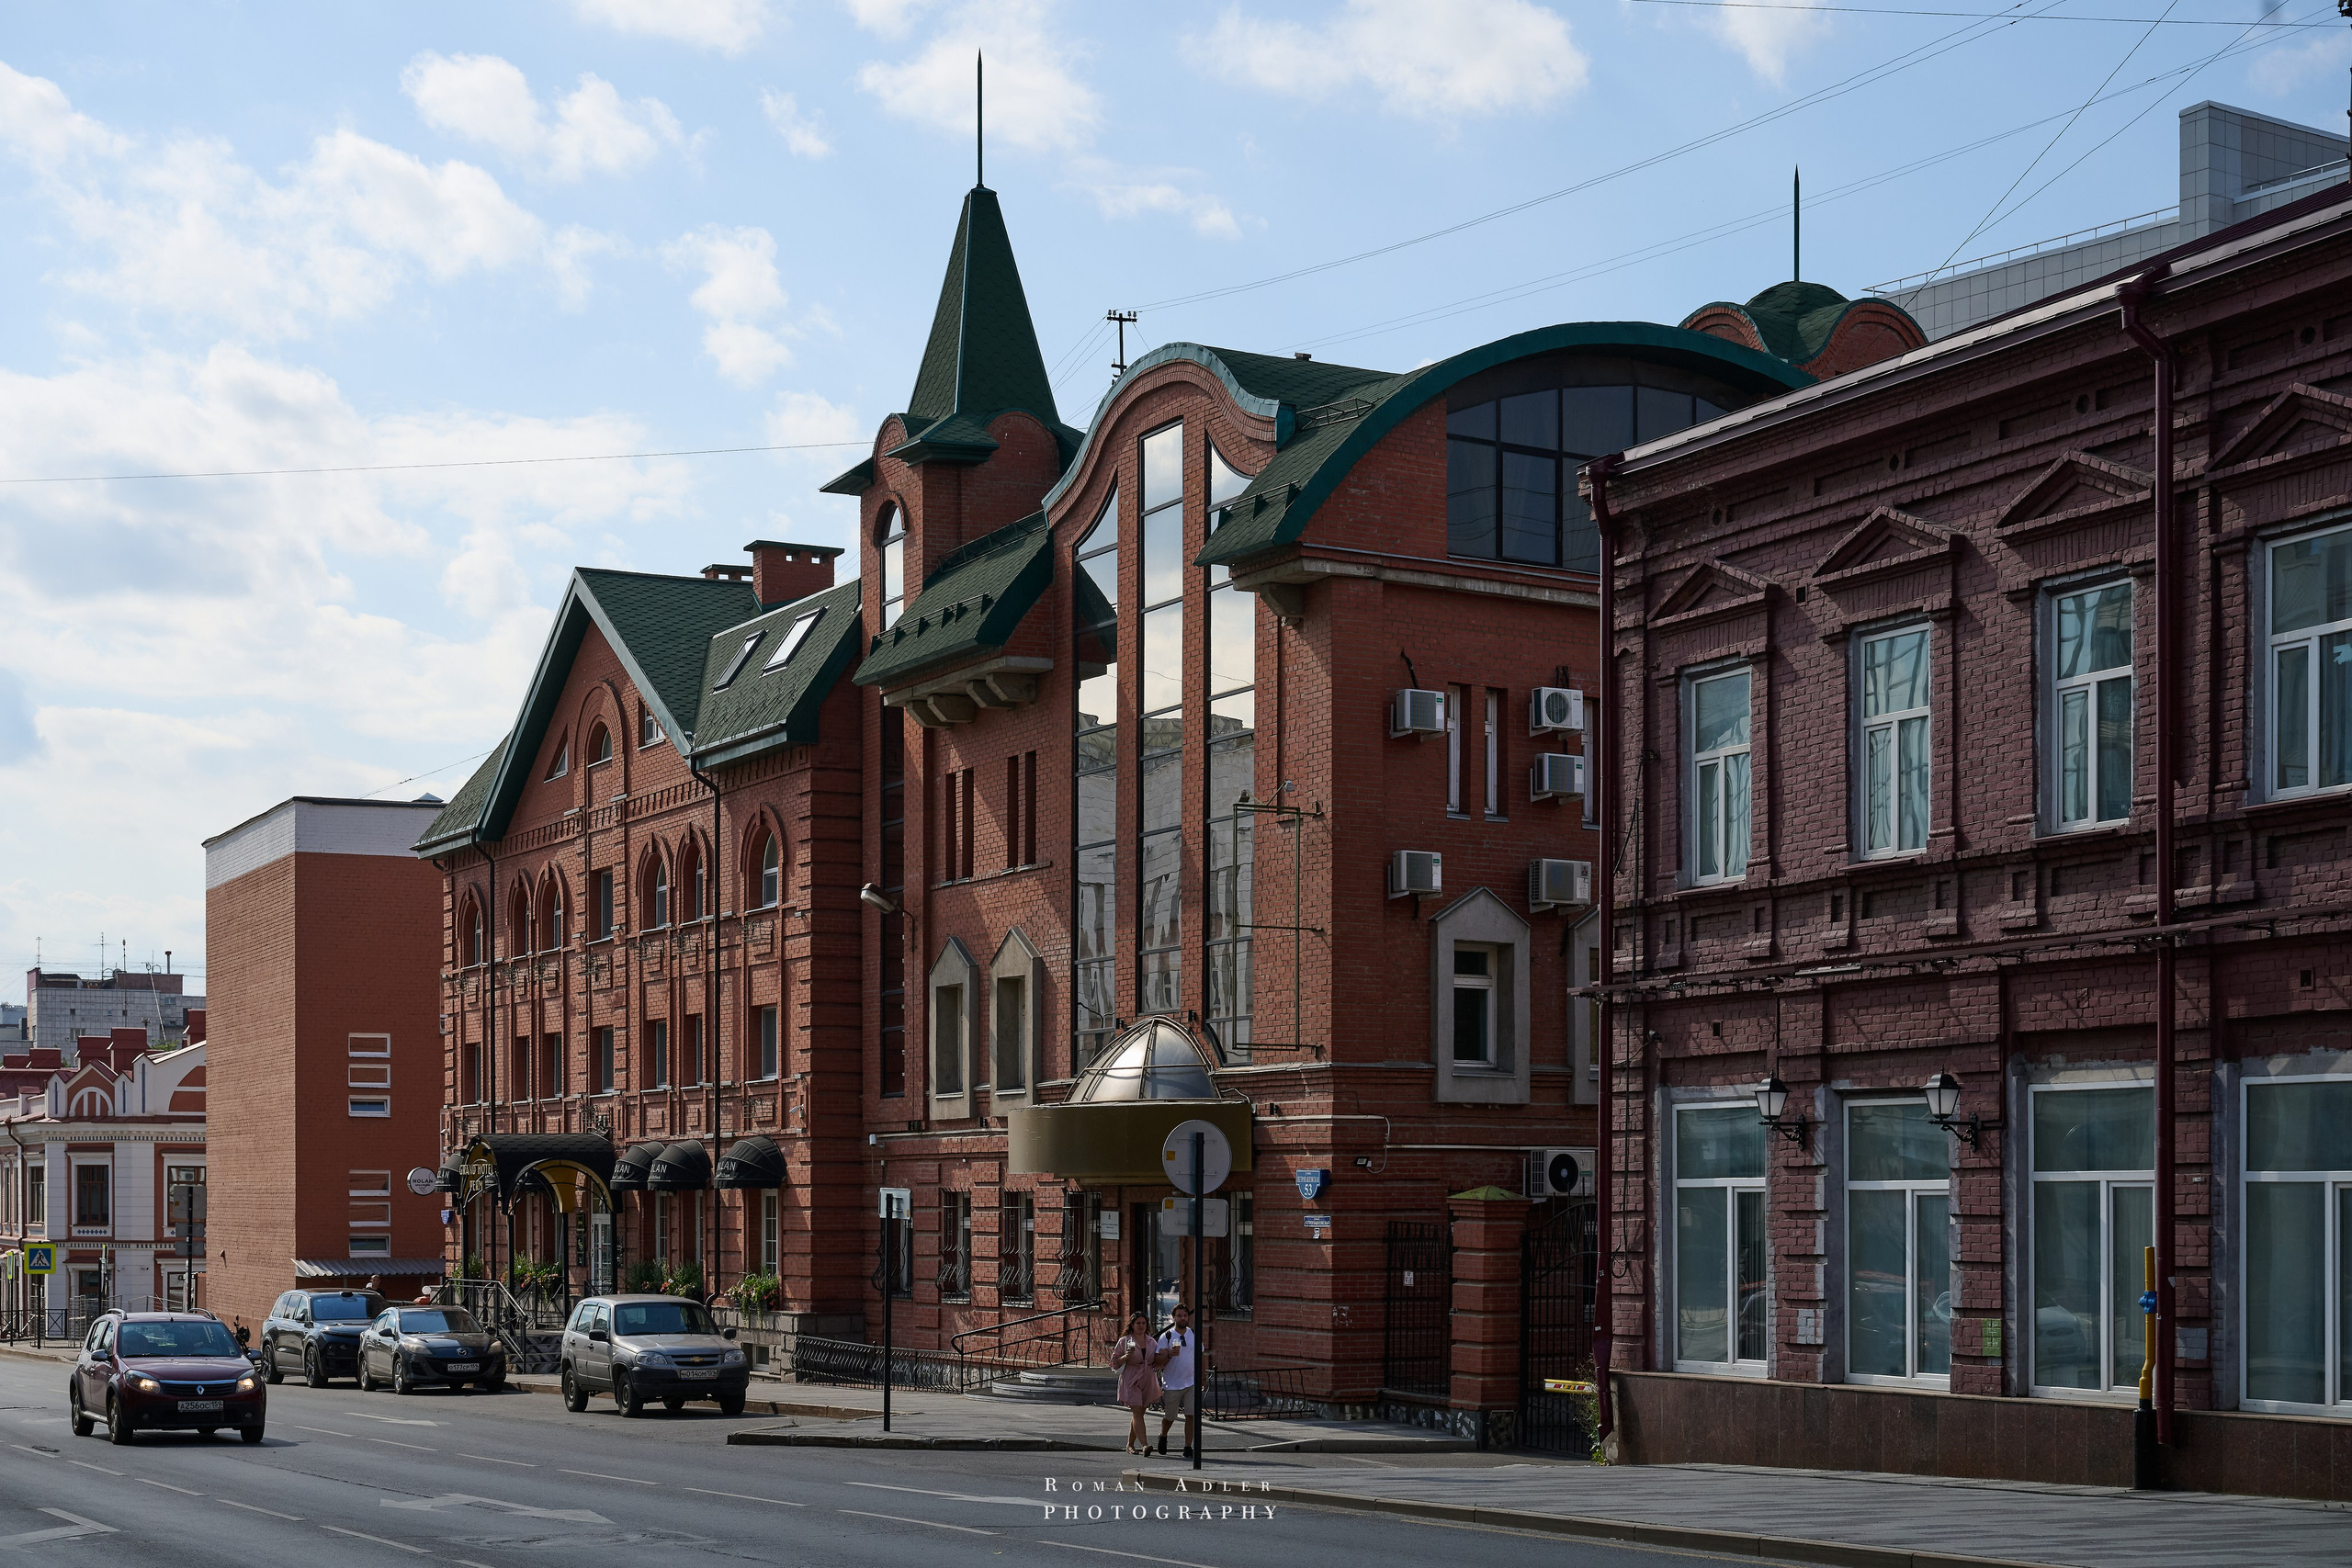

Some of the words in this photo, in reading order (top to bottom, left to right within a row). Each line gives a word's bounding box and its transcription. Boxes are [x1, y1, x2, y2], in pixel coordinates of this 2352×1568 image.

[477, 1163, 494, 1175] HOTEL
[469, 1179, 483, 1191] PERM
[1304, 1183, 1313, 1196] 53
